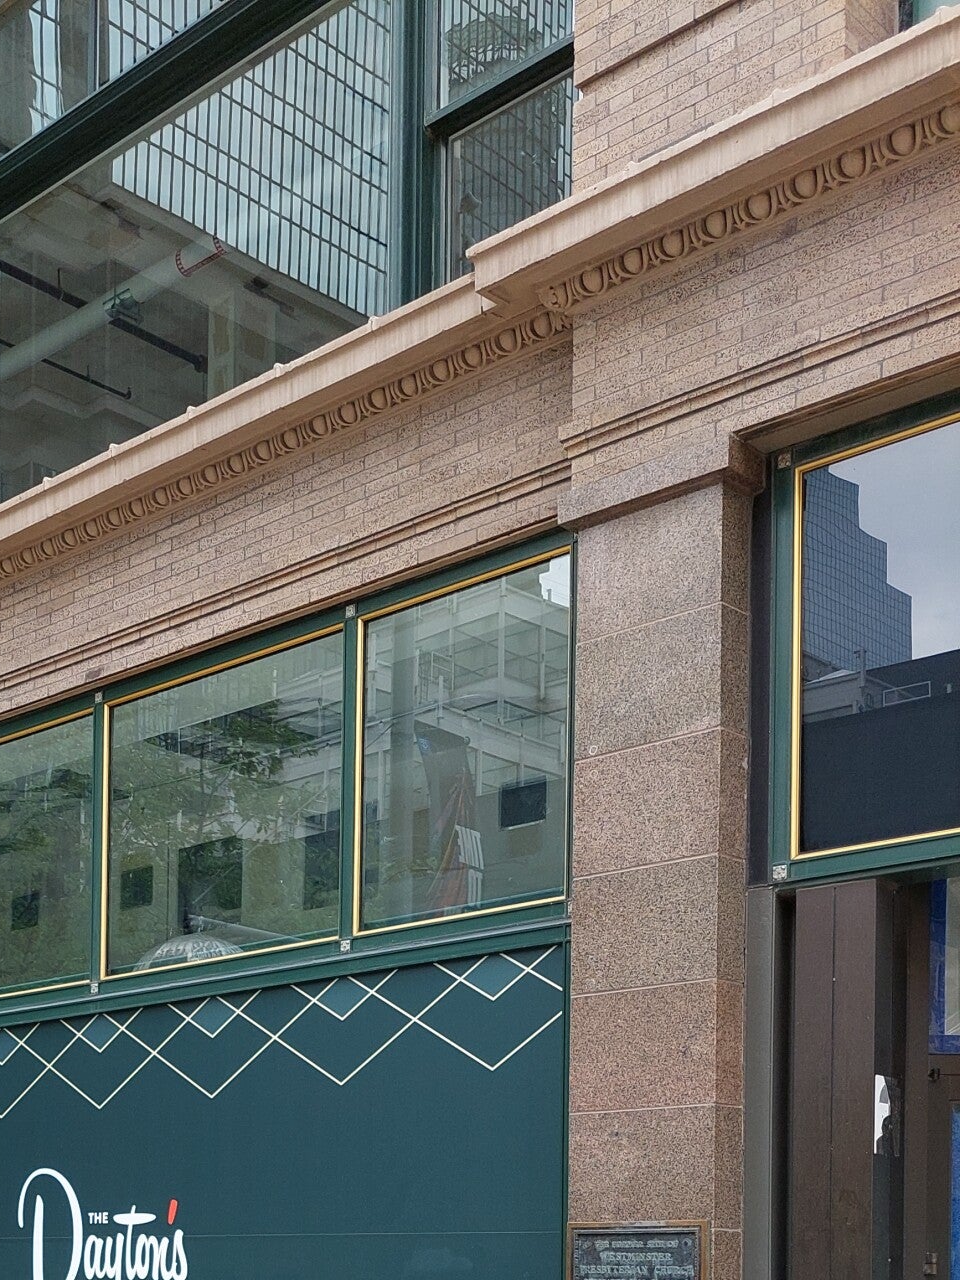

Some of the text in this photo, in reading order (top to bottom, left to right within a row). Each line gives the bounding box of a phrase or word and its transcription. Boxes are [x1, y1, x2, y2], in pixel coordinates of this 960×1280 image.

[87, 1211, 109, 1225] THE
[599, 1251, 673, 1262] WESTMINSTER
[579, 1264, 694, 1276] PRESBYTERIAN CHURCH
